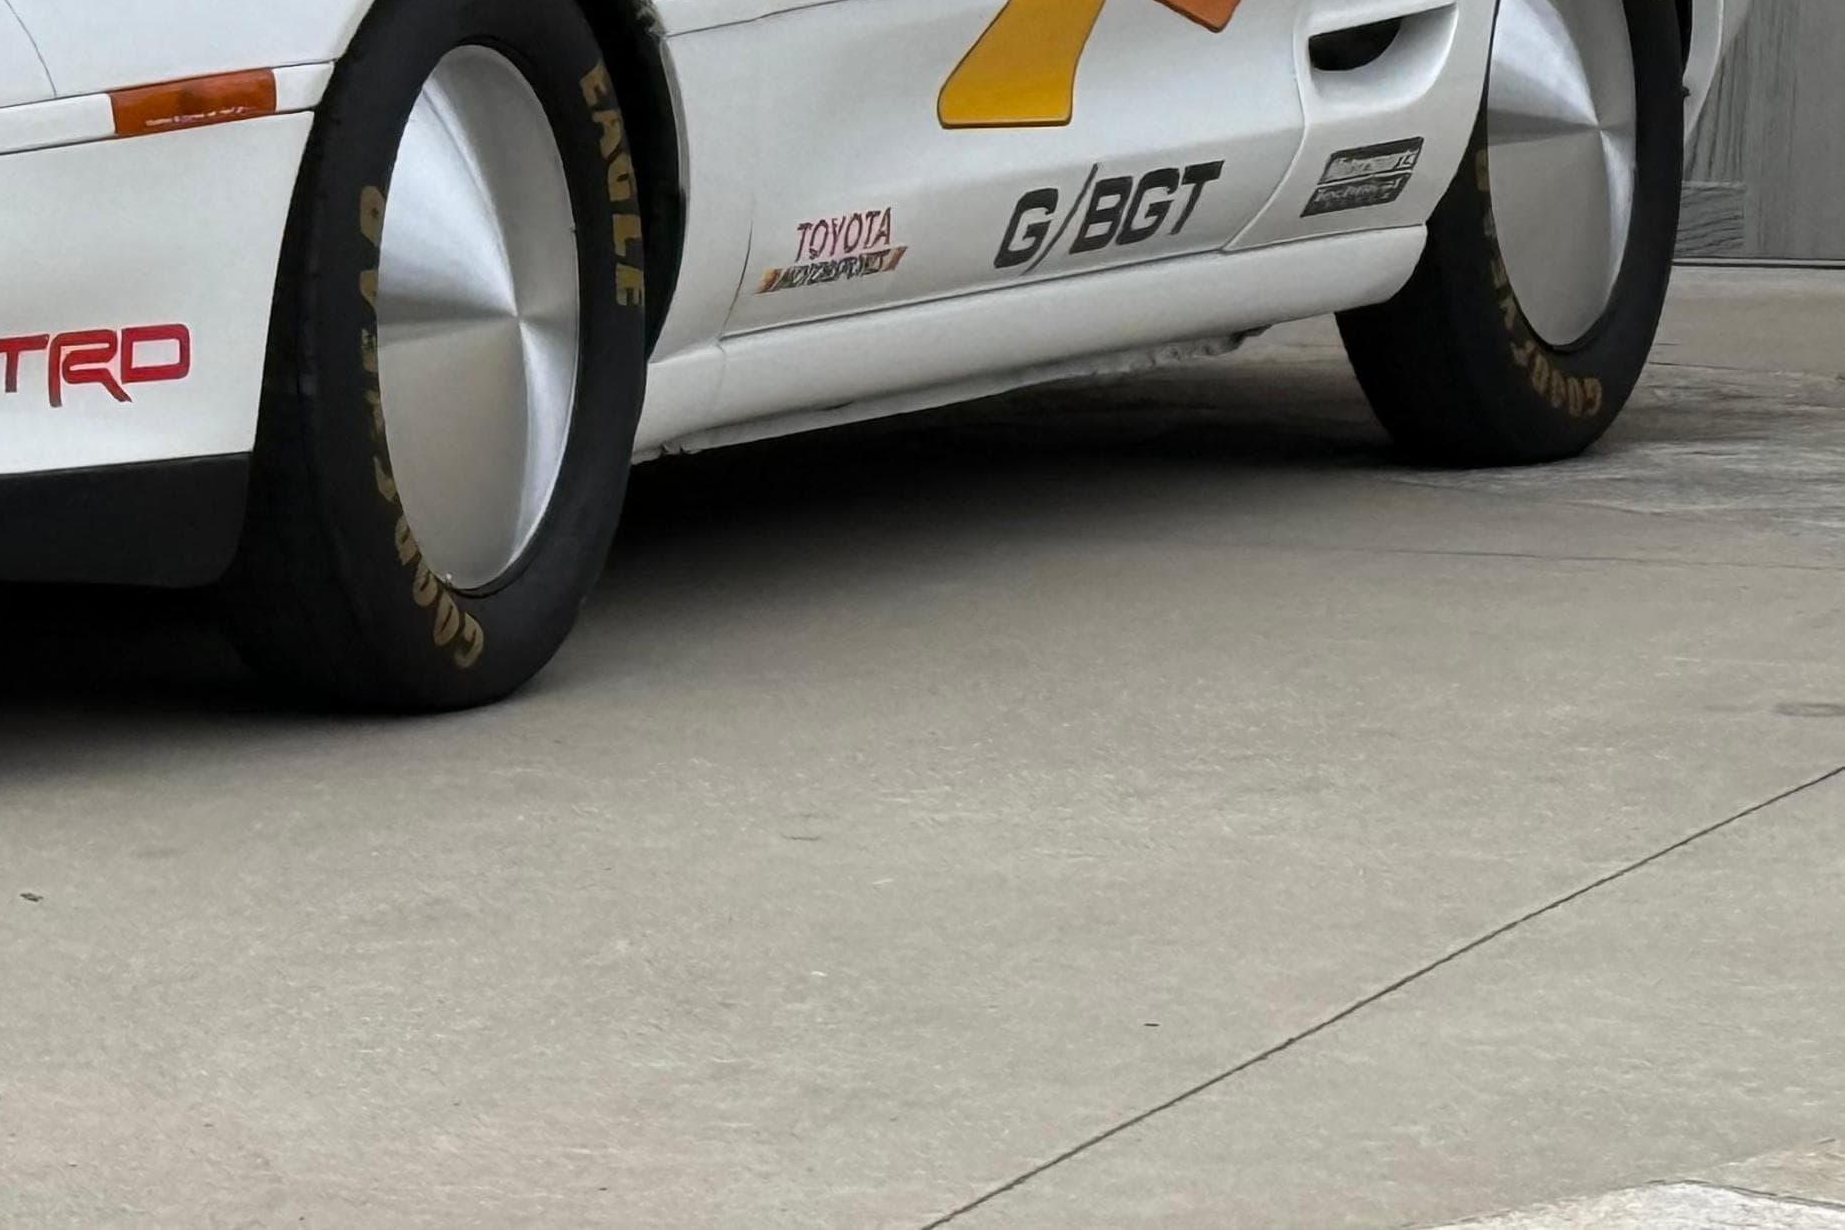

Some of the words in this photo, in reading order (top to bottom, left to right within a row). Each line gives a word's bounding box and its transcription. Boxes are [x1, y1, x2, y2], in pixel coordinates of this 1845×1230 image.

[578, 61, 646, 306] EAGLE
[795, 206, 892, 263] TOYOTA
[992, 159, 1226, 277] G/BGT
